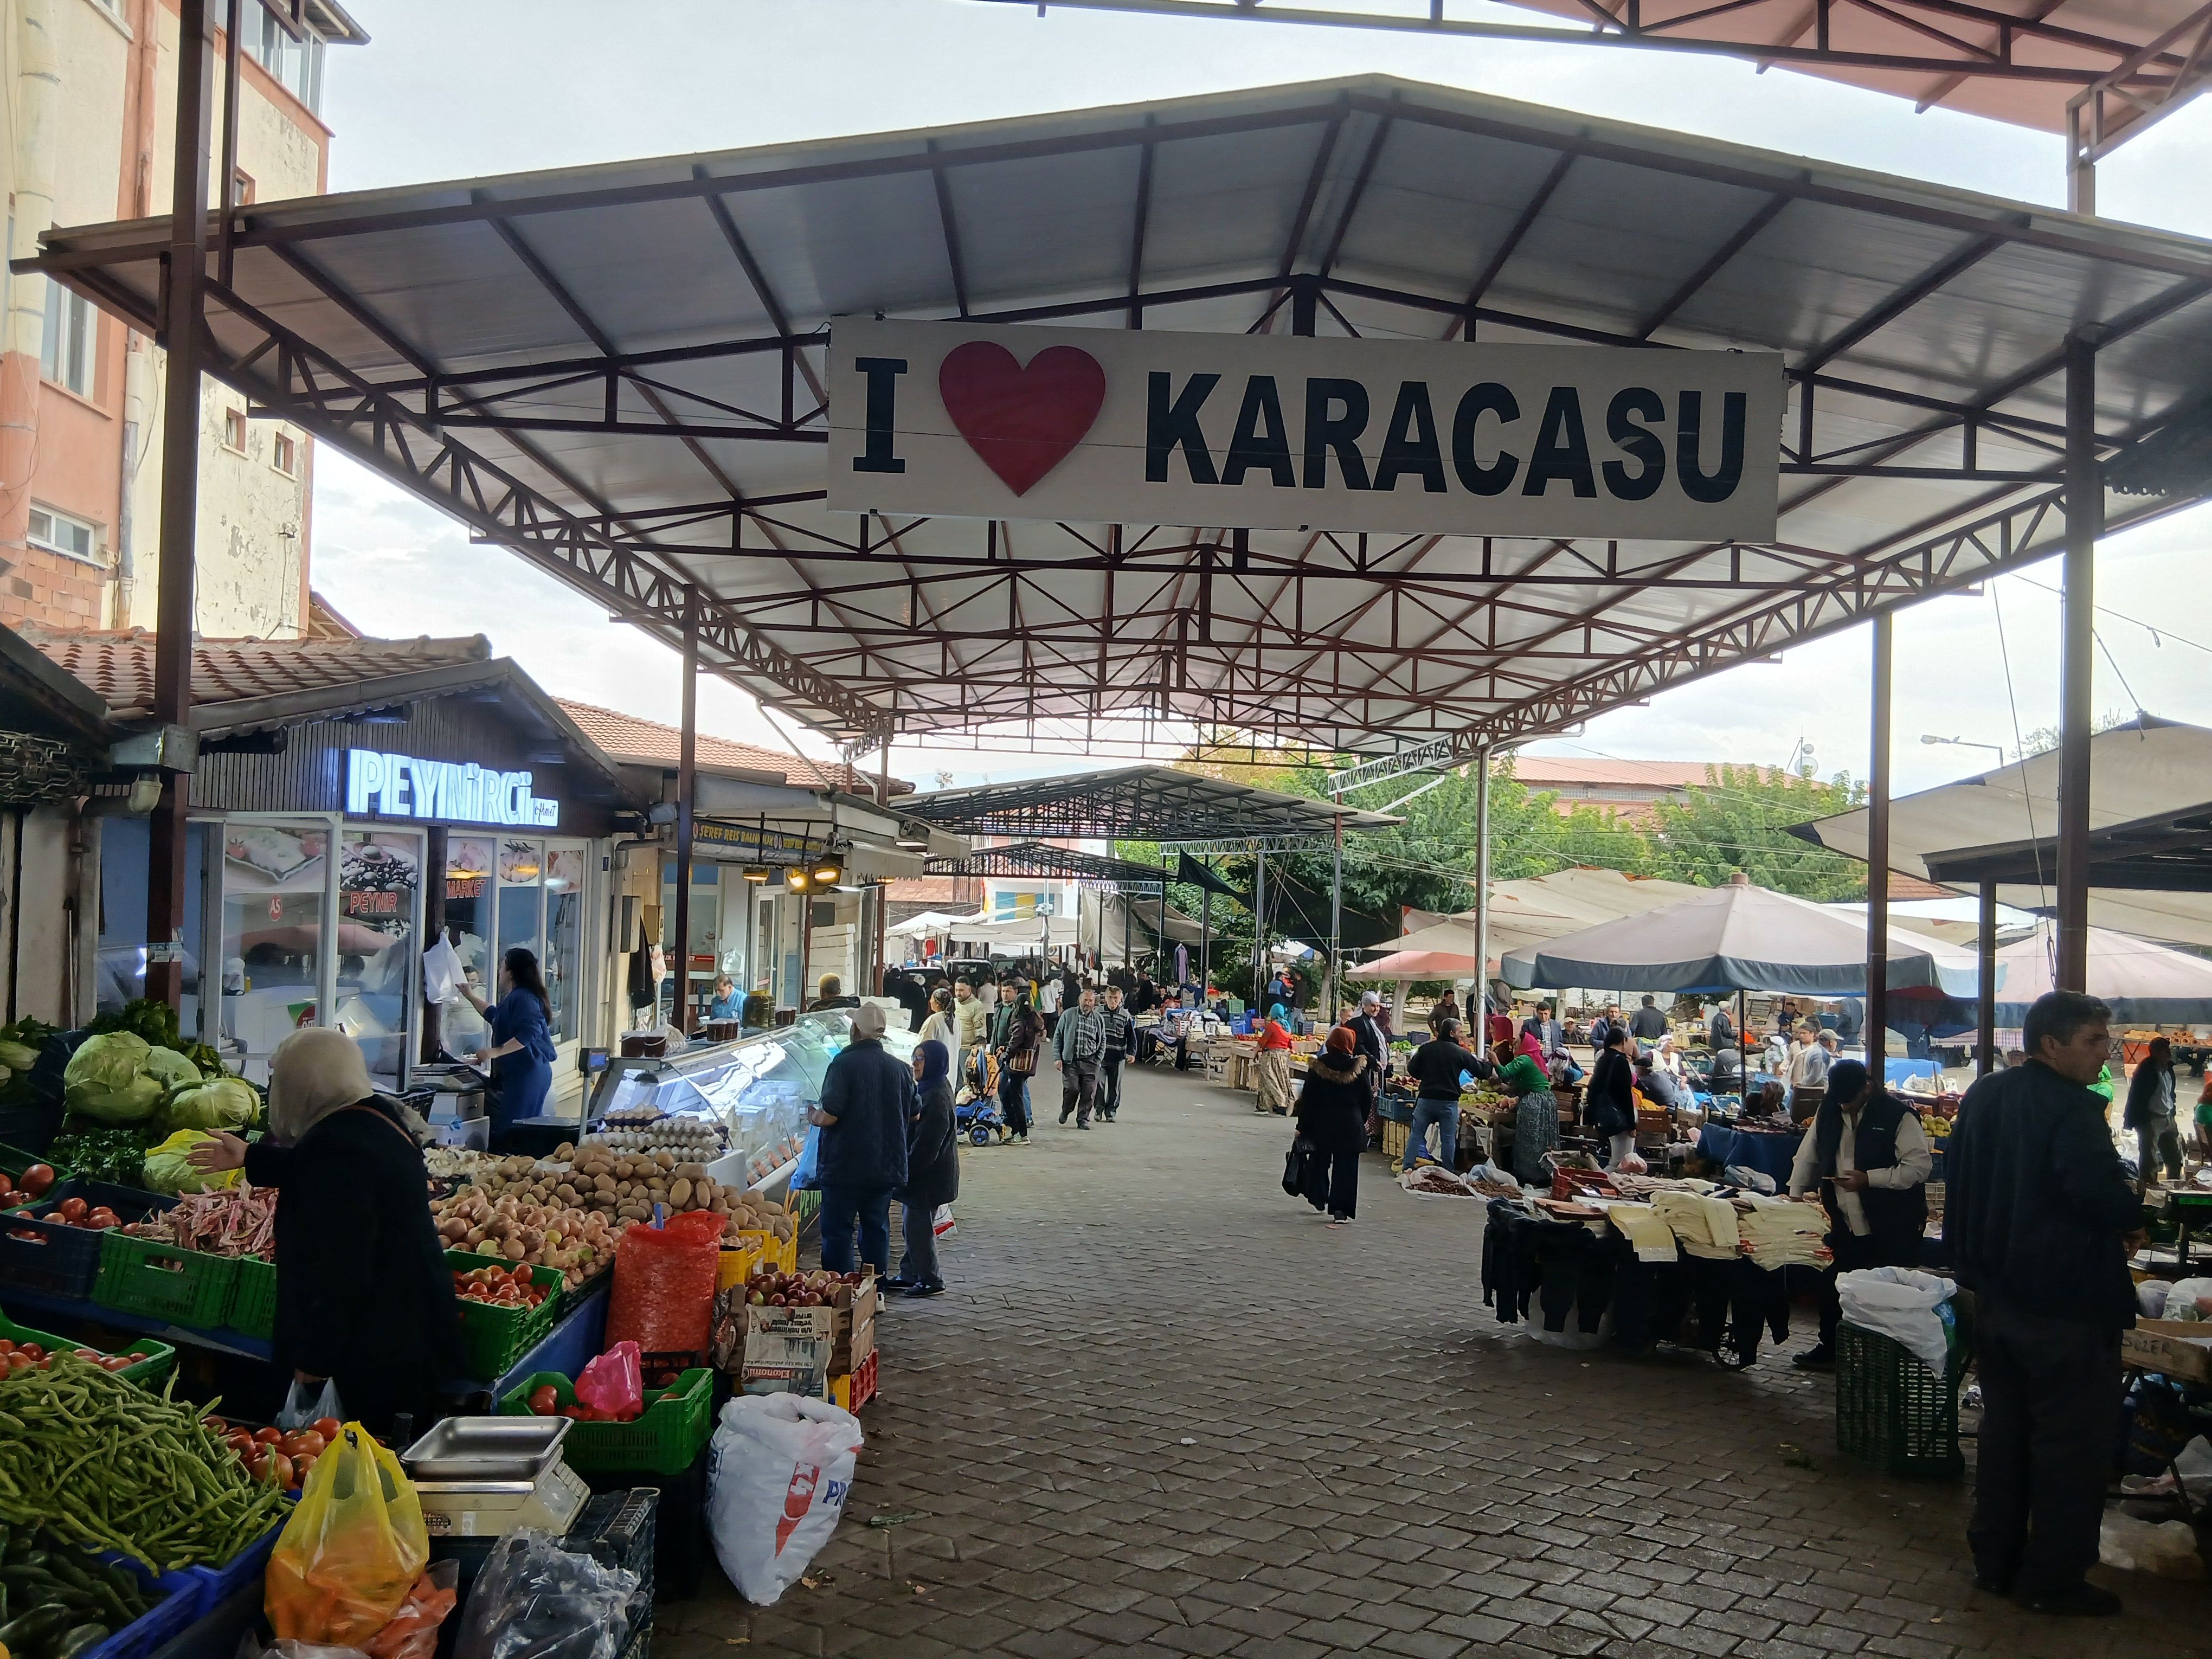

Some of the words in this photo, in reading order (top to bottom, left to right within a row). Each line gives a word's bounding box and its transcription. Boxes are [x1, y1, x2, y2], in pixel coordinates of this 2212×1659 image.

[853, 357, 908, 473] I
[1144, 370, 1747, 502] KARACASU
[534, 802, 557, 823] Ahmet
[446, 879, 486, 899] MARKET
[271, 899, 281, 913] AS
